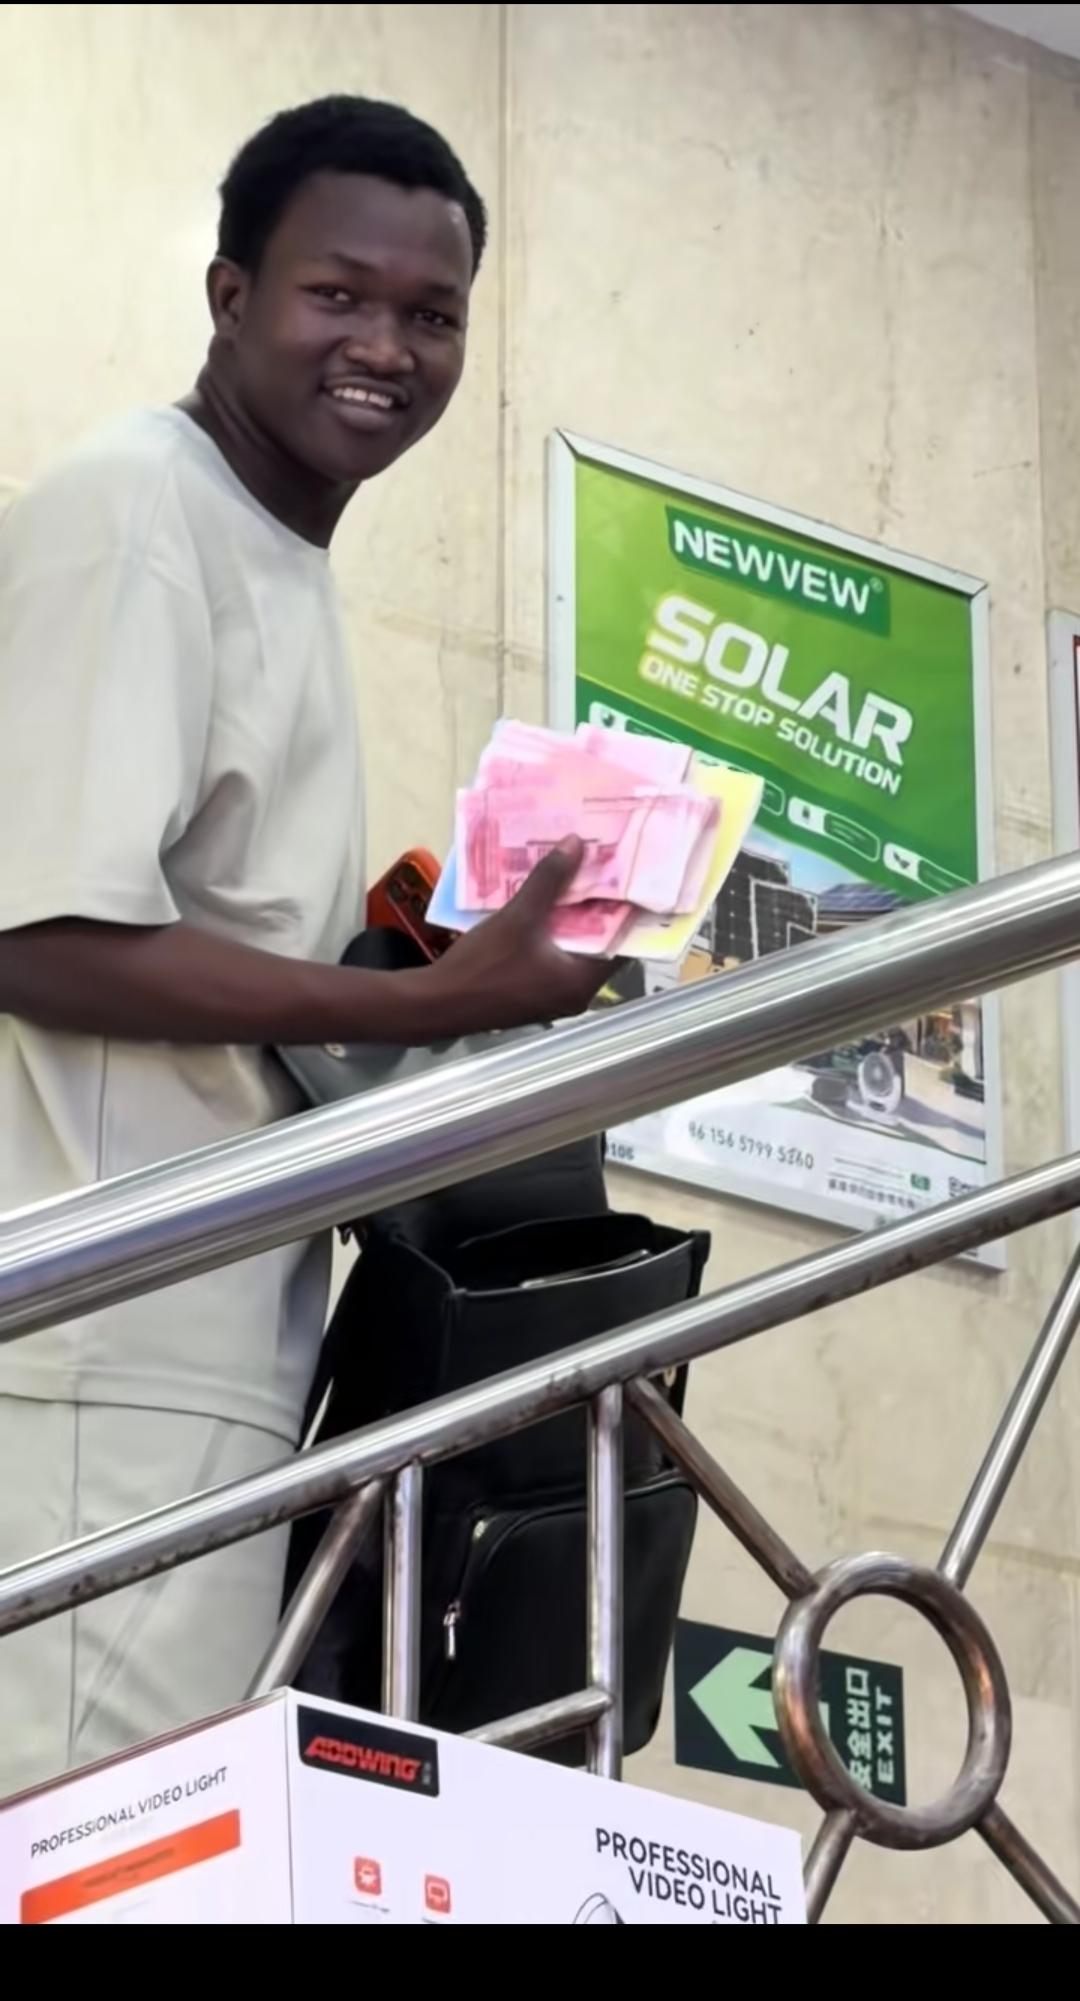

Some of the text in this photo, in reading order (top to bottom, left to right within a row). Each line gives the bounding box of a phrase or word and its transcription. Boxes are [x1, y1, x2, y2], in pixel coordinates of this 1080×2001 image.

[642, 653, 902, 796] ONE STOP SOLUTION
[647, 594, 913, 766] SOLAR
[711, 1127, 735, 1149] 156
[740, 1134, 773, 1159] 5799
[875, 1685, 895, 1785] EXIT
[30, 1806, 136, 1859] PROFESSIONAL
[138, 1785, 183, 1820] VIDEO
[186, 1766, 228, 1797] LIGHT
[596, 1827, 782, 1900] PROFESSIONAL
[628, 1866, 783, 1924] VIDEO LIGHT
